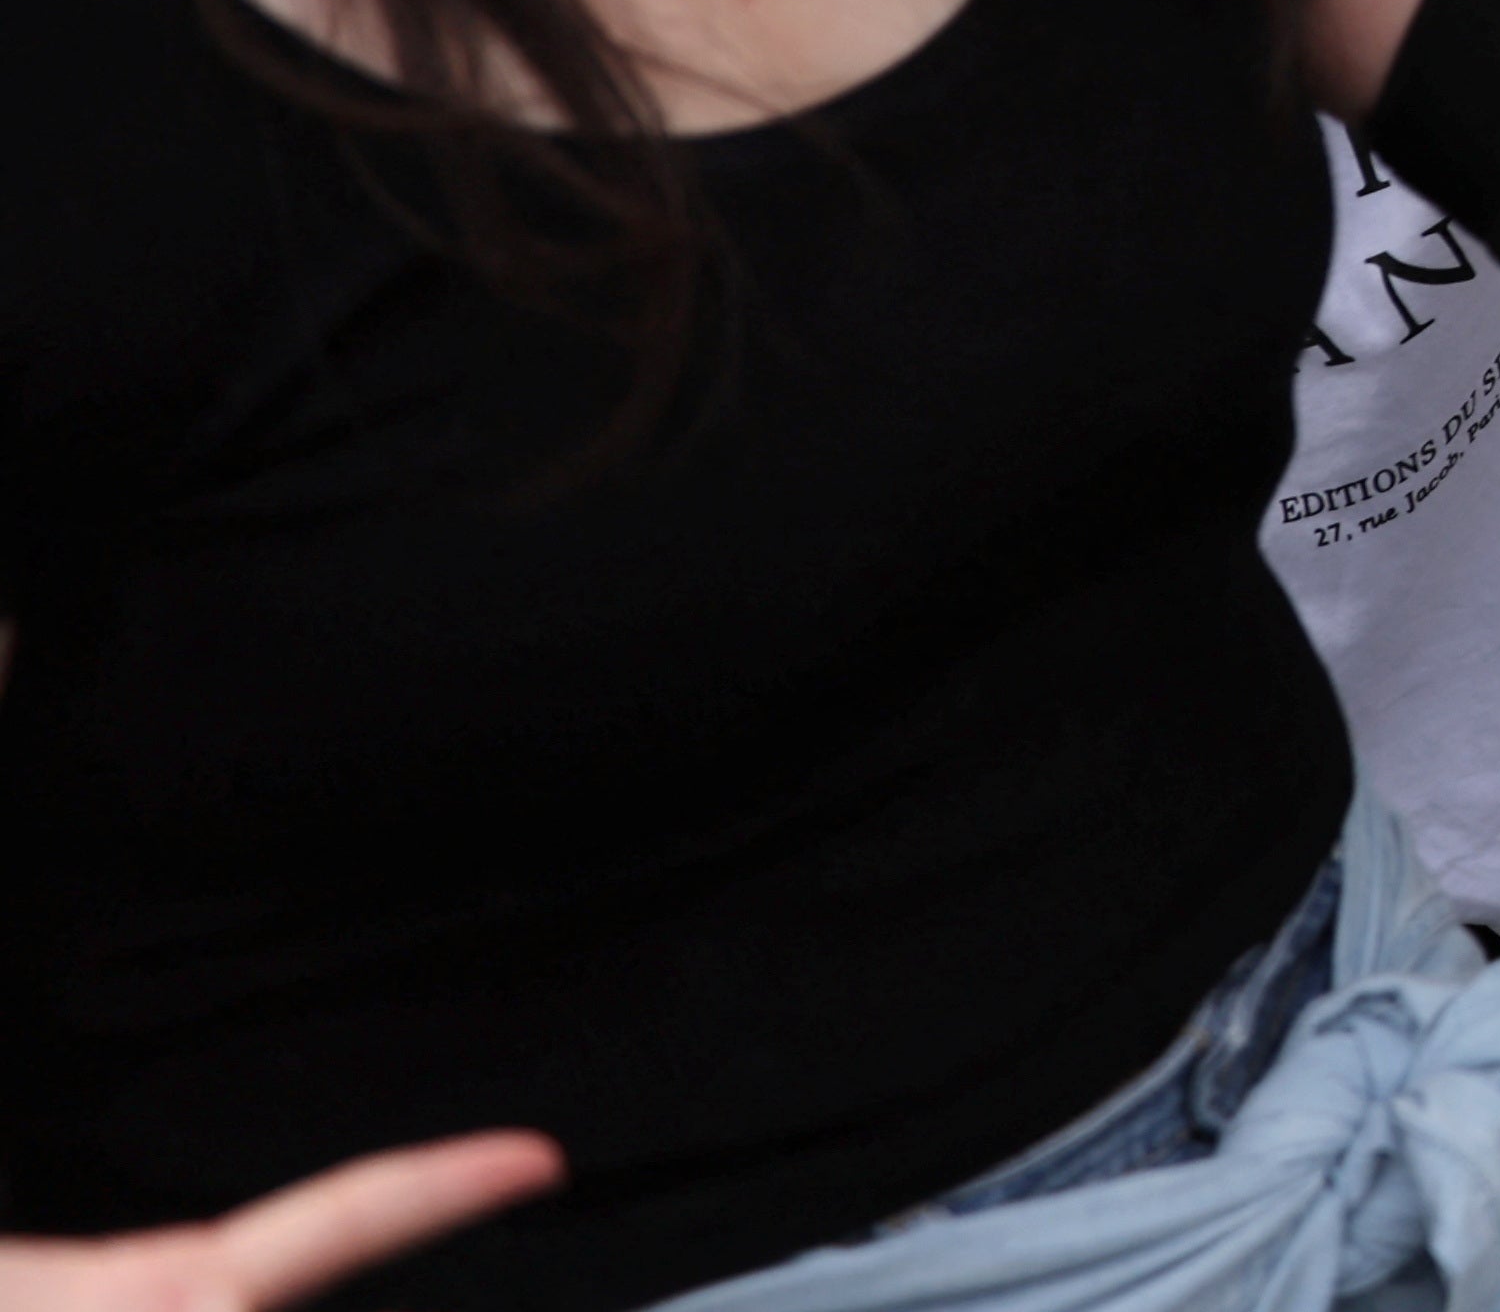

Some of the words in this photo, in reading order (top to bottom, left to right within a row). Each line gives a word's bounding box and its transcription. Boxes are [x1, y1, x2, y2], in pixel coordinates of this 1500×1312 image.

[1279, 441, 1437, 524] EDITIONS
[1442, 390, 1477, 444] DU
[1358, 507, 1399, 534] rue
